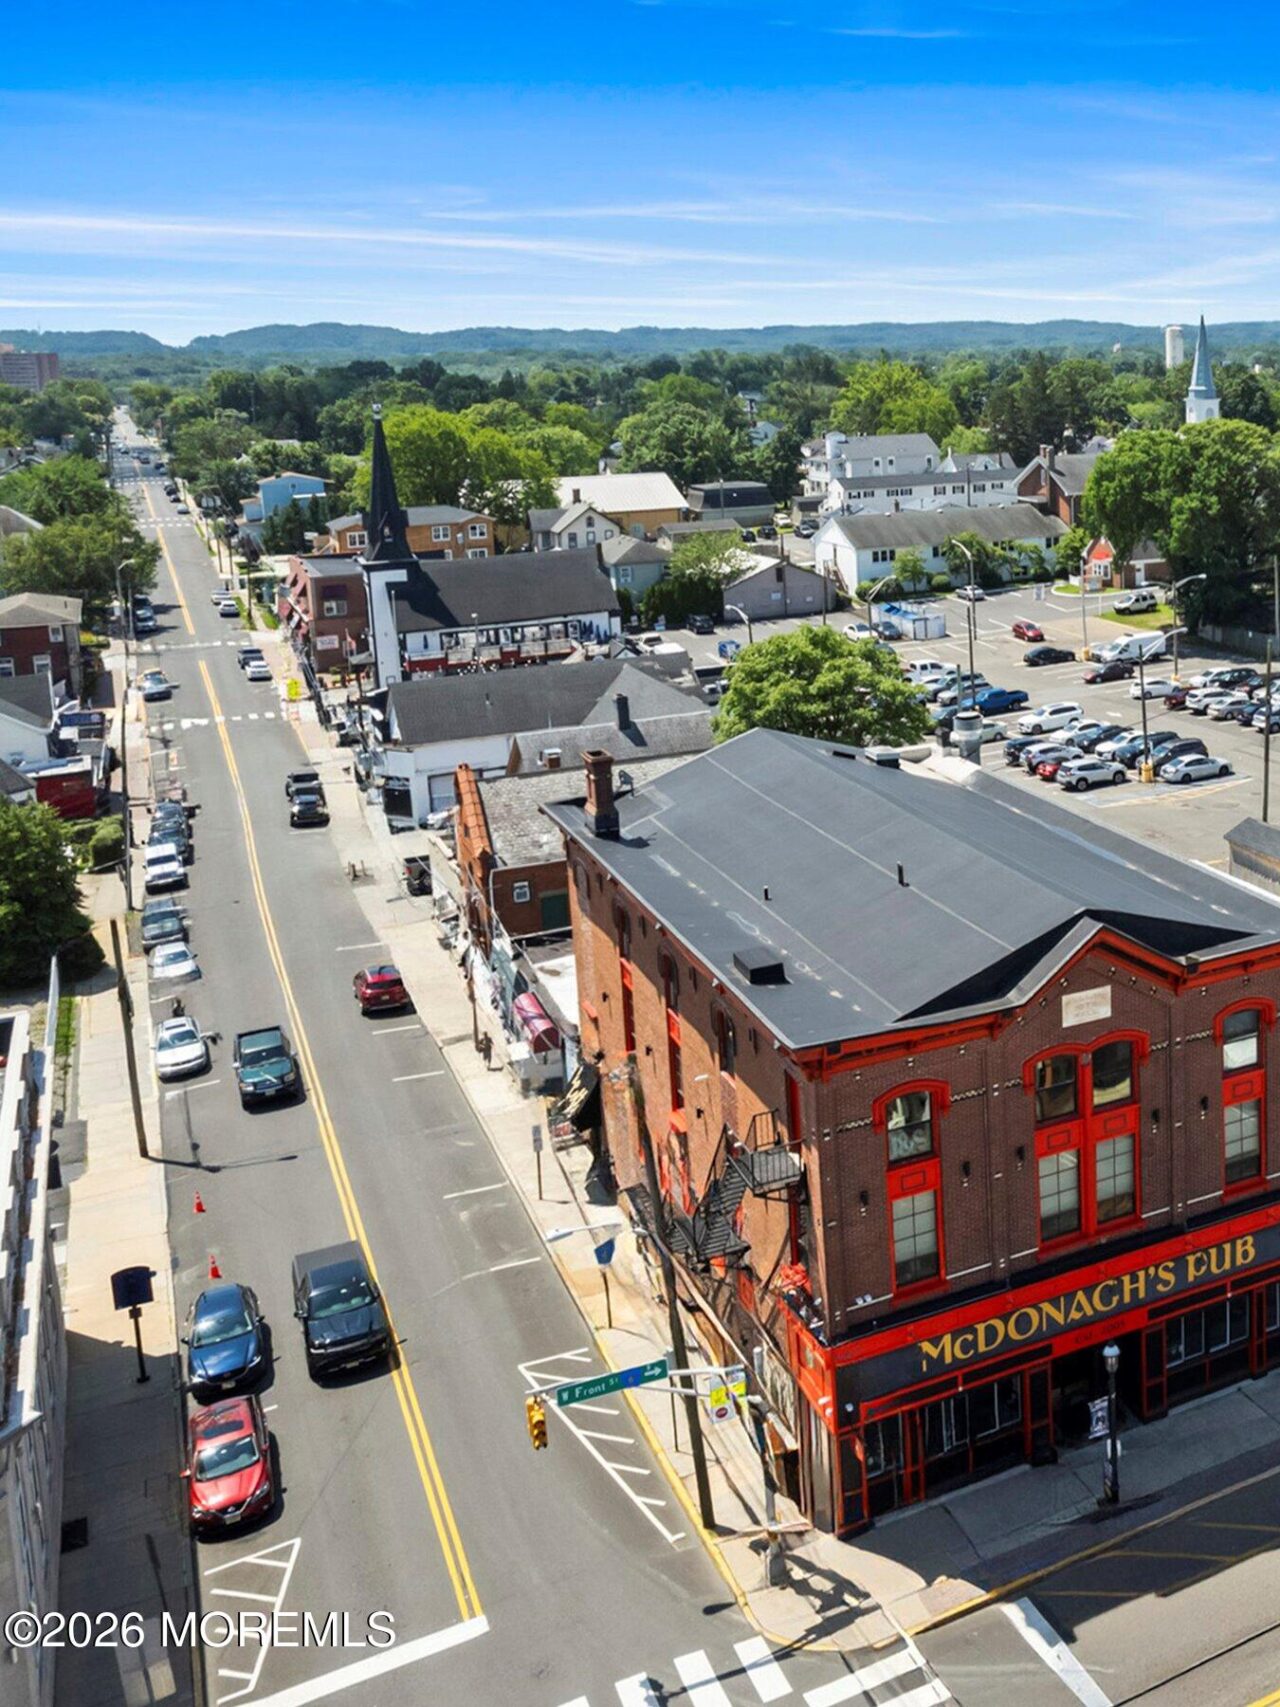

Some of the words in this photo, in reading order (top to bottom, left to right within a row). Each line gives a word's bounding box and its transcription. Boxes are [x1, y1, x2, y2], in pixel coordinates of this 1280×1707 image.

[1186, 1235, 1257, 1282] PUB
[561, 1390, 569, 1401] W
[575, 1383, 607, 1399] Front
[609, 1377, 619, 1385] St
